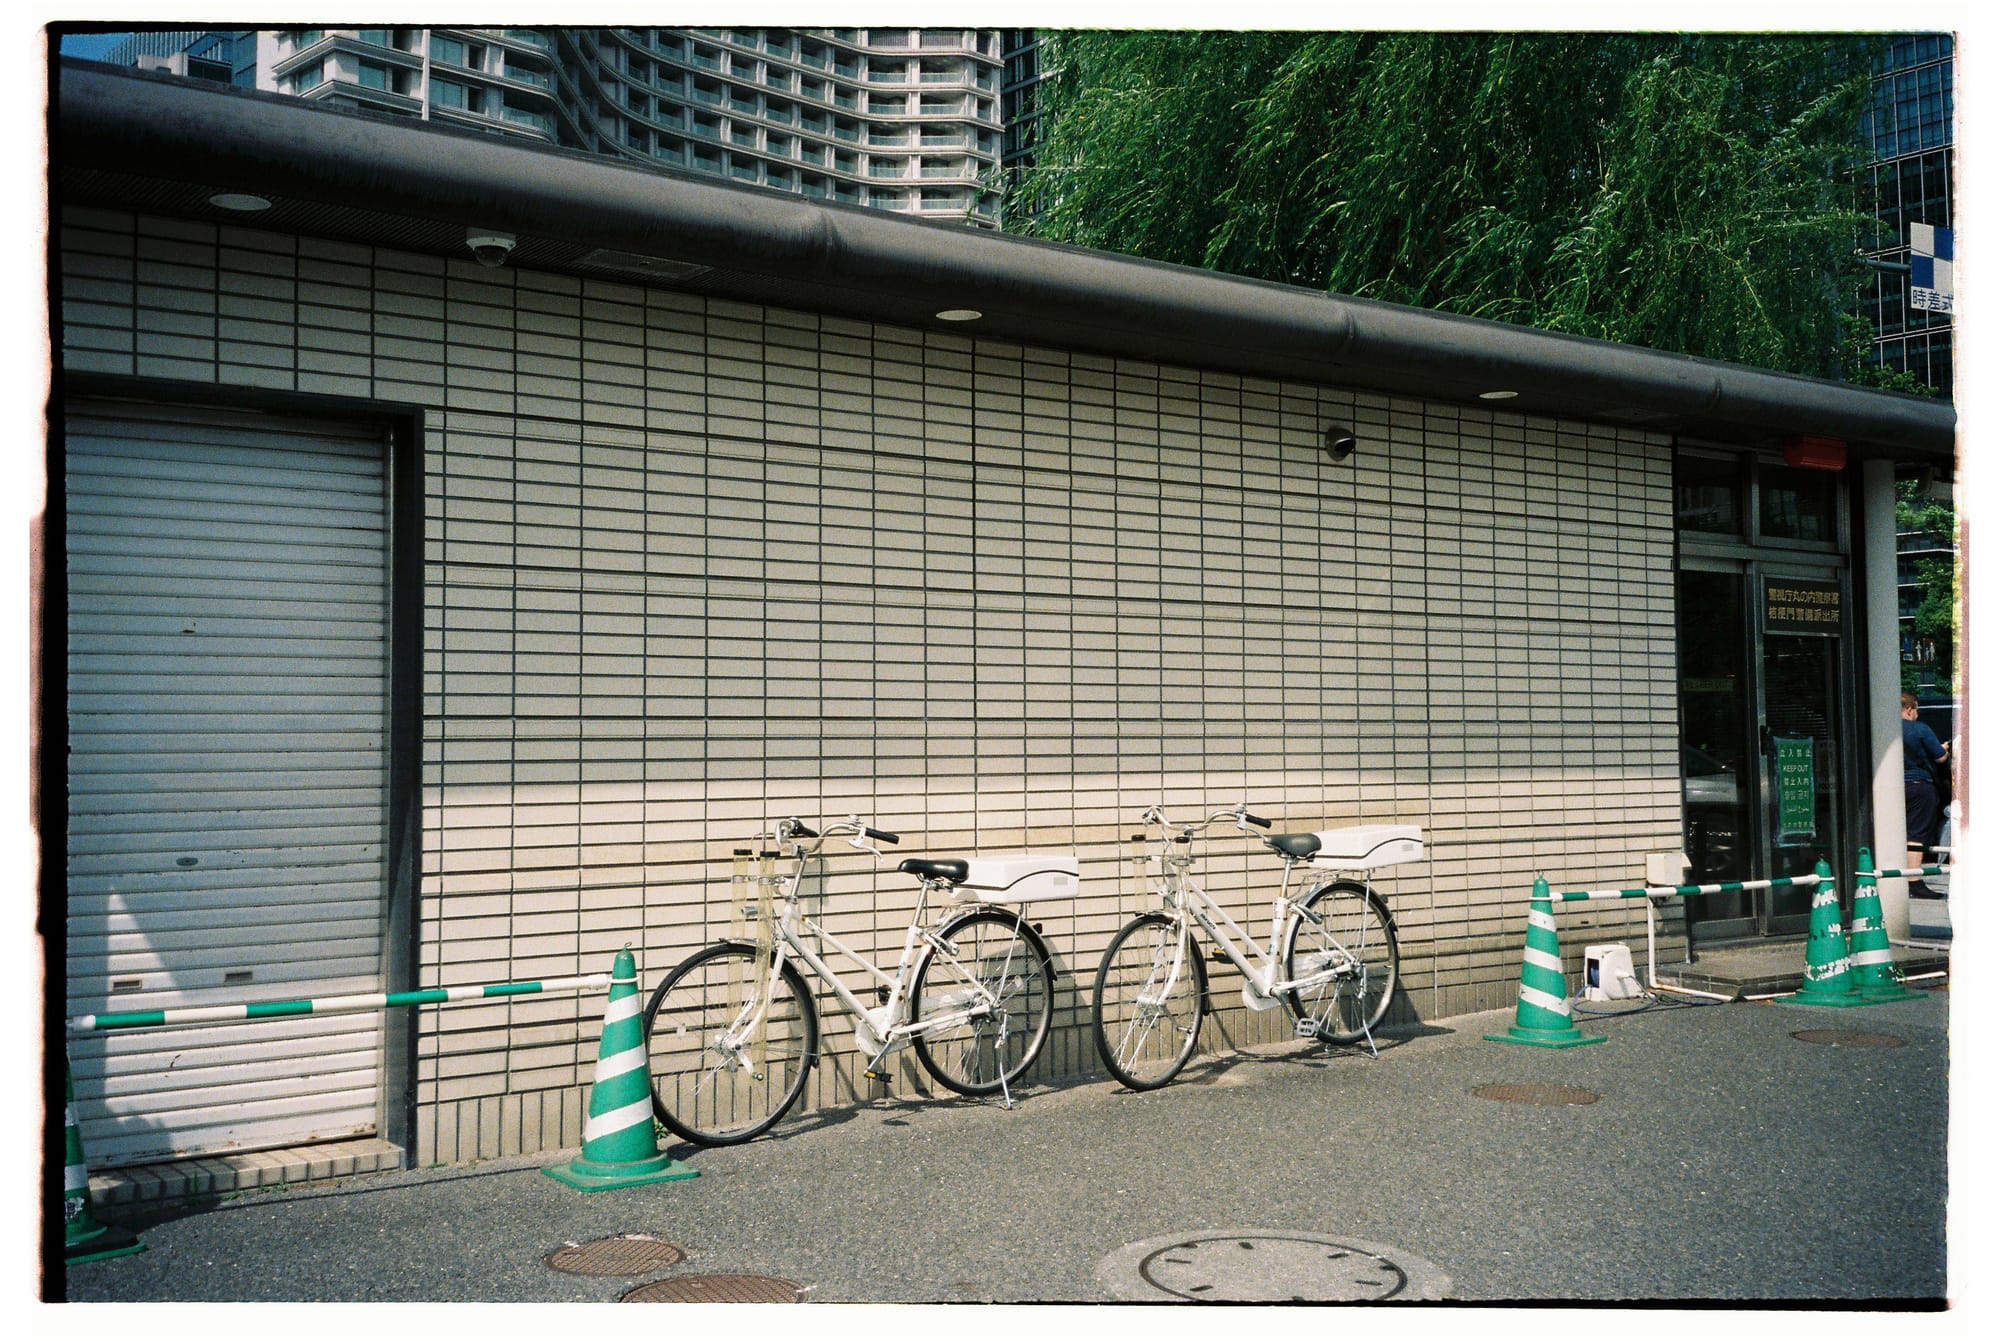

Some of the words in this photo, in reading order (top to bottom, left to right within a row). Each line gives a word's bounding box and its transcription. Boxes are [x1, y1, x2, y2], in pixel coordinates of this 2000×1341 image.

[1913, 289, 1954, 311] 時差式
[1768, 587, 1839, 605] 警視庁丸の内警察署
